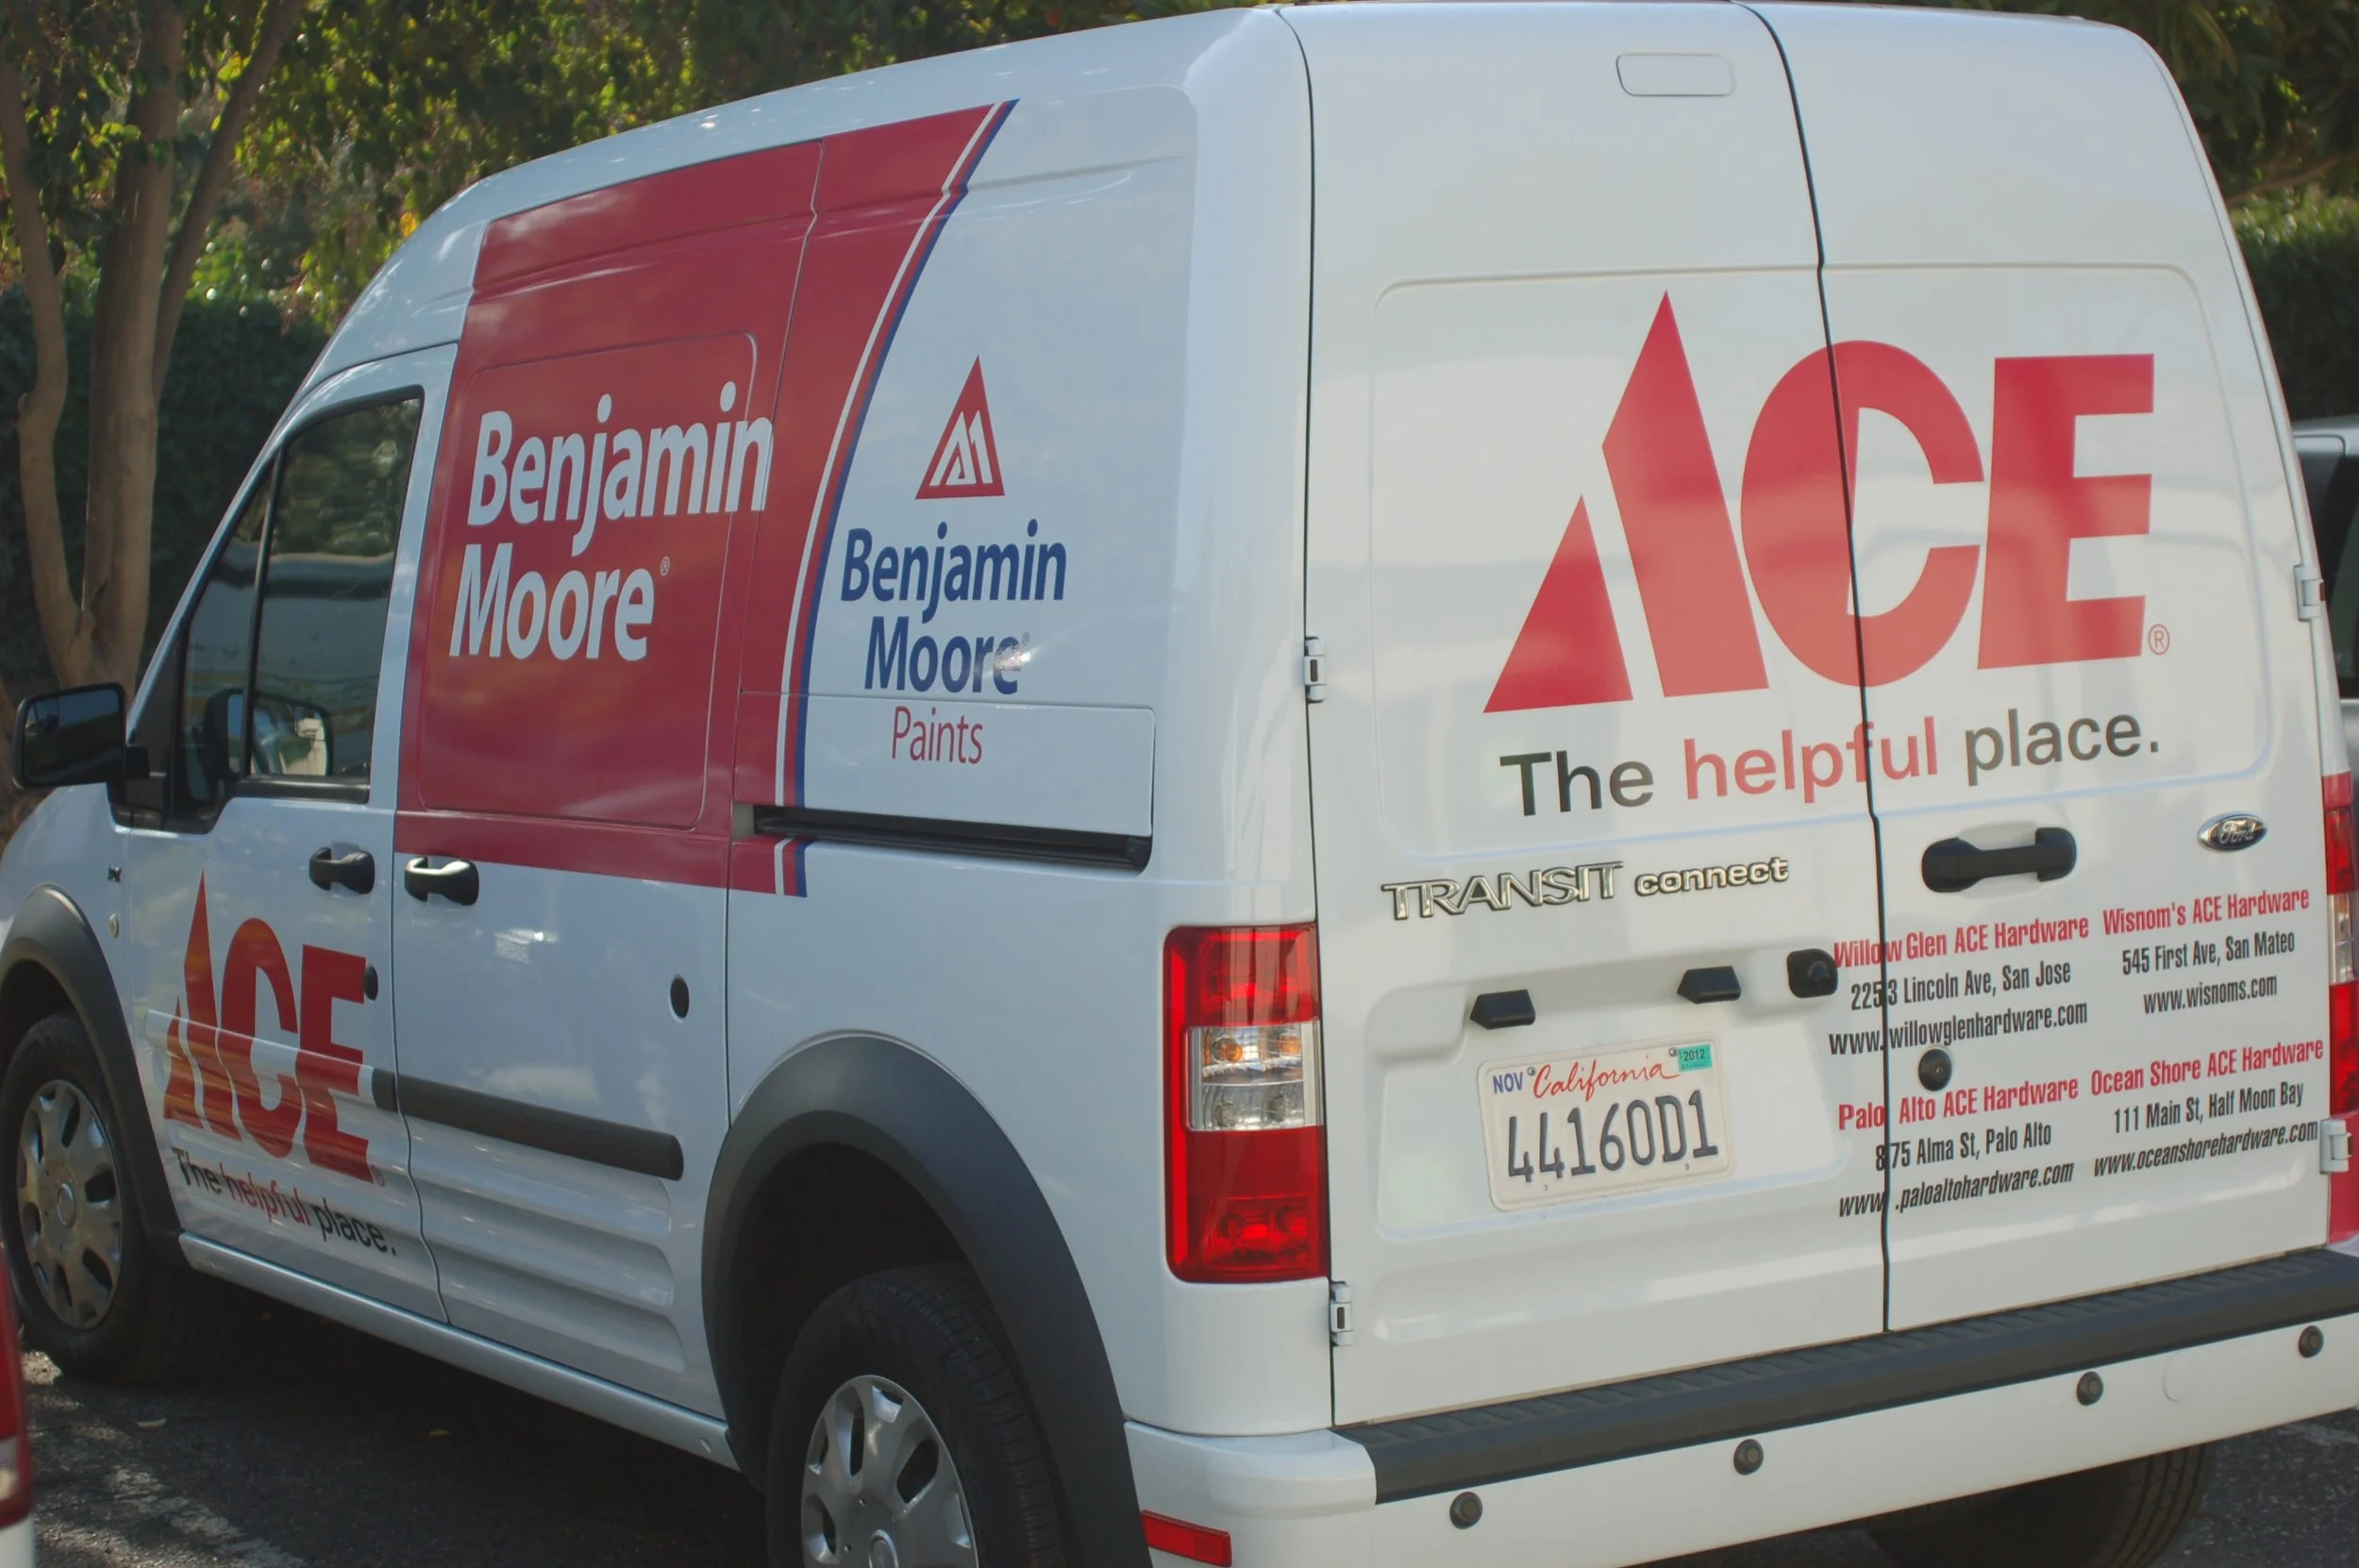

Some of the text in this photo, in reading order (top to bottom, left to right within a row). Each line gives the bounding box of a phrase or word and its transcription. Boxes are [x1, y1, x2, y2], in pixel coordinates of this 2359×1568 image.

[467, 381, 774, 556] Benjamin
[1482, 290, 2154, 713] ACE
[840, 518, 1067, 623] Benjamin
[449, 543, 654, 661] Moore
[864, 615, 1021, 694] Moore
[892, 706, 984, 764] Paints
[1499, 709, 2159, 817] The helpful place.
[1381, 857, 1790, 921] TRANSIT connect
[2103, 889, 2310, 935] Wisnom's ACE Hardware
[1834, 917, 2089, 968] Willow Glen ACE Hardware
[2122, 931, 2295, 976] 545 First Ave, San Mateo
[1850, 960, 2071, 1010] 2253 Lincoln Ave, San Jose
[2143, 976, 2277, 1014] www.wisnoms.com
[163, 870, 374, 1184] ACE
[1493, 1048, 1706, 1102] NOV California 2012
[2091, 1039, 2323, 1095] Ocean Shore ACE Hardware
[1839, 1078, 2079, 1130] Palo Alto ACE Hardware
[2115, 1081, 2304, 1133] 111 Main St, Half Moon Bay
[1509, 1090, 1718, 1182] 44160D1
[1875, 1122, 2051, 1171] 875 Alma St, Palo Alto
[2094, 1121, 2318, 1176] www.oceanshorehardware.com
[171, 1146, 397, 1257] The helpful place.
